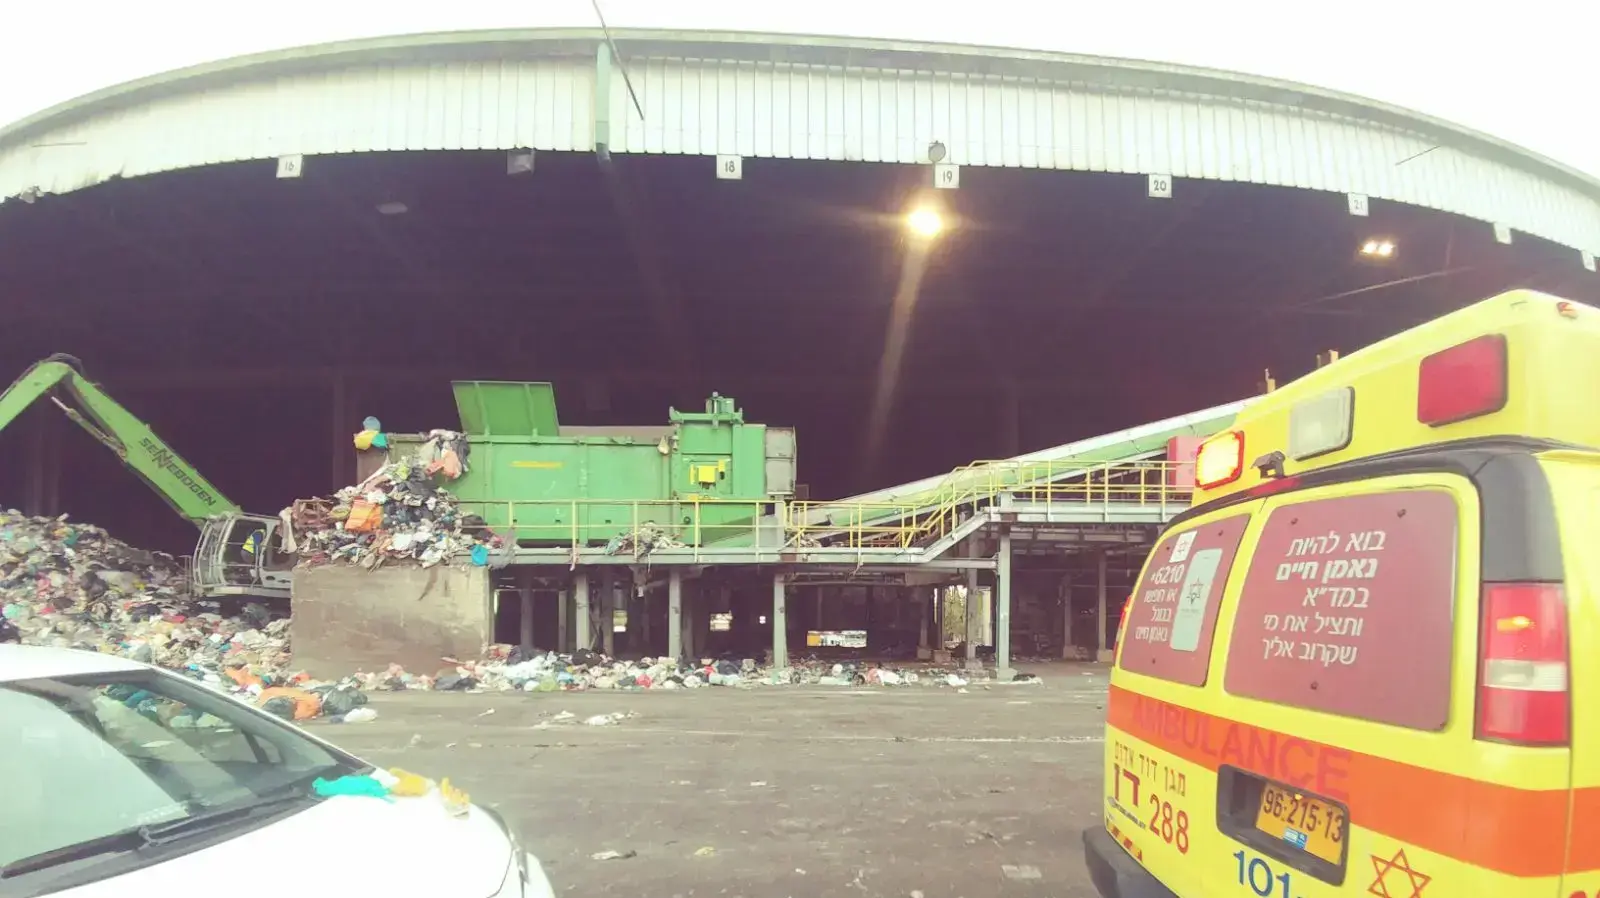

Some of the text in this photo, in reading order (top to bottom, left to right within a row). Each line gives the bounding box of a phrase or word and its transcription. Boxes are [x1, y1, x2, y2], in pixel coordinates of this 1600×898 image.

[285, 160, 295, 172] 16
[724, 160, 735, 173] 18
[942, 170, 953, 183] 19
[1153, 179, 1167, 192] 20
[1354, 199, 1364, 210] 21
[139, 436, 217, 506] SENNEBOGEN
[1285, 530, 1386, 557] בוא להיות
[1276, 557, 1378, 584] נאמן חיים
[1263, 612, 1364, 637] ותציל את מי
[1262, 636, 1358, 667] שקרוב אליך
[1131, 695, 1352, 802] AMBULANCE
[1114, 740, 1186, 797] מגן דוד אדום
[1113, 763, 1141, 807] דן
[1149, 794, 1189, 856] 288
[1233, 850, 1290, 898] 101
